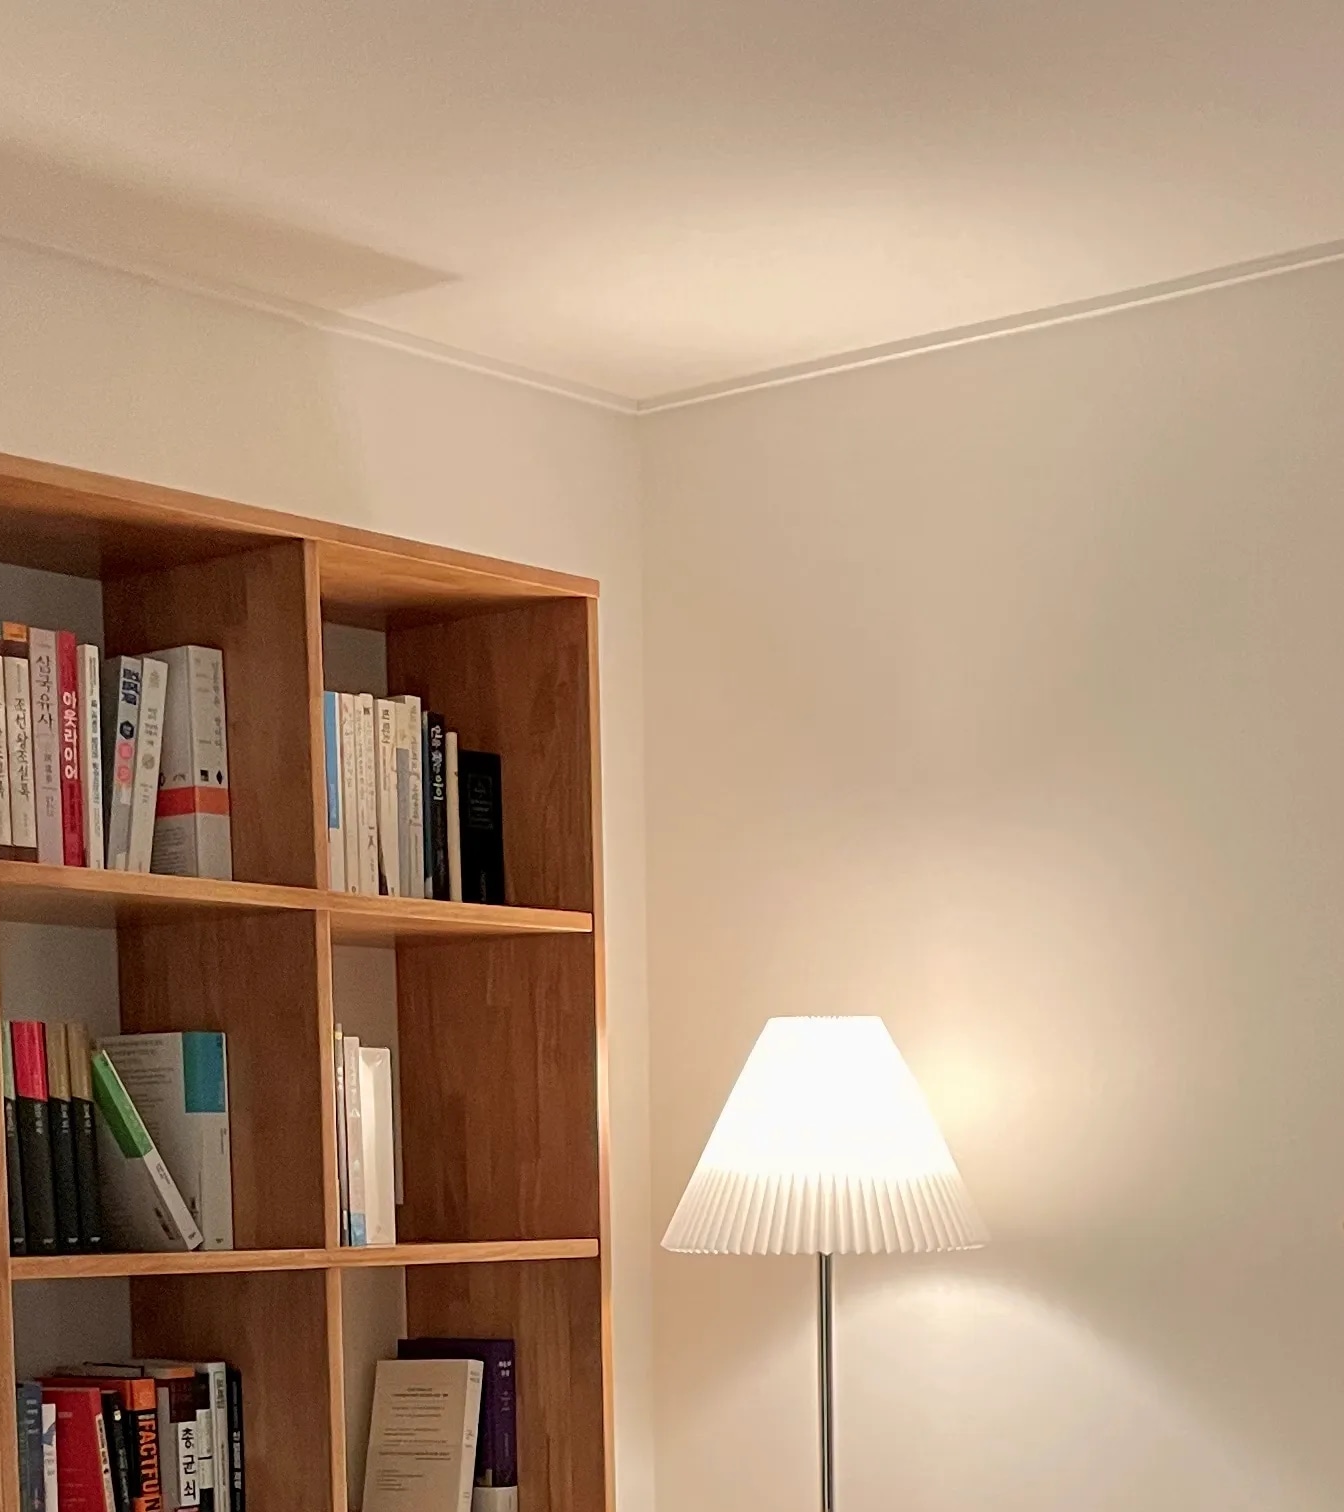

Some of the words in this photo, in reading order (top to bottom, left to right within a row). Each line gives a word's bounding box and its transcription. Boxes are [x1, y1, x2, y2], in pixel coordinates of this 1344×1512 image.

[36, 654, 54, 732] 삼국유사
[13, 697, 31, 802] 조선왕조실록
[62, 691, 78, 781] 아웃라이어
[433, 774, 444, 801] 아이
